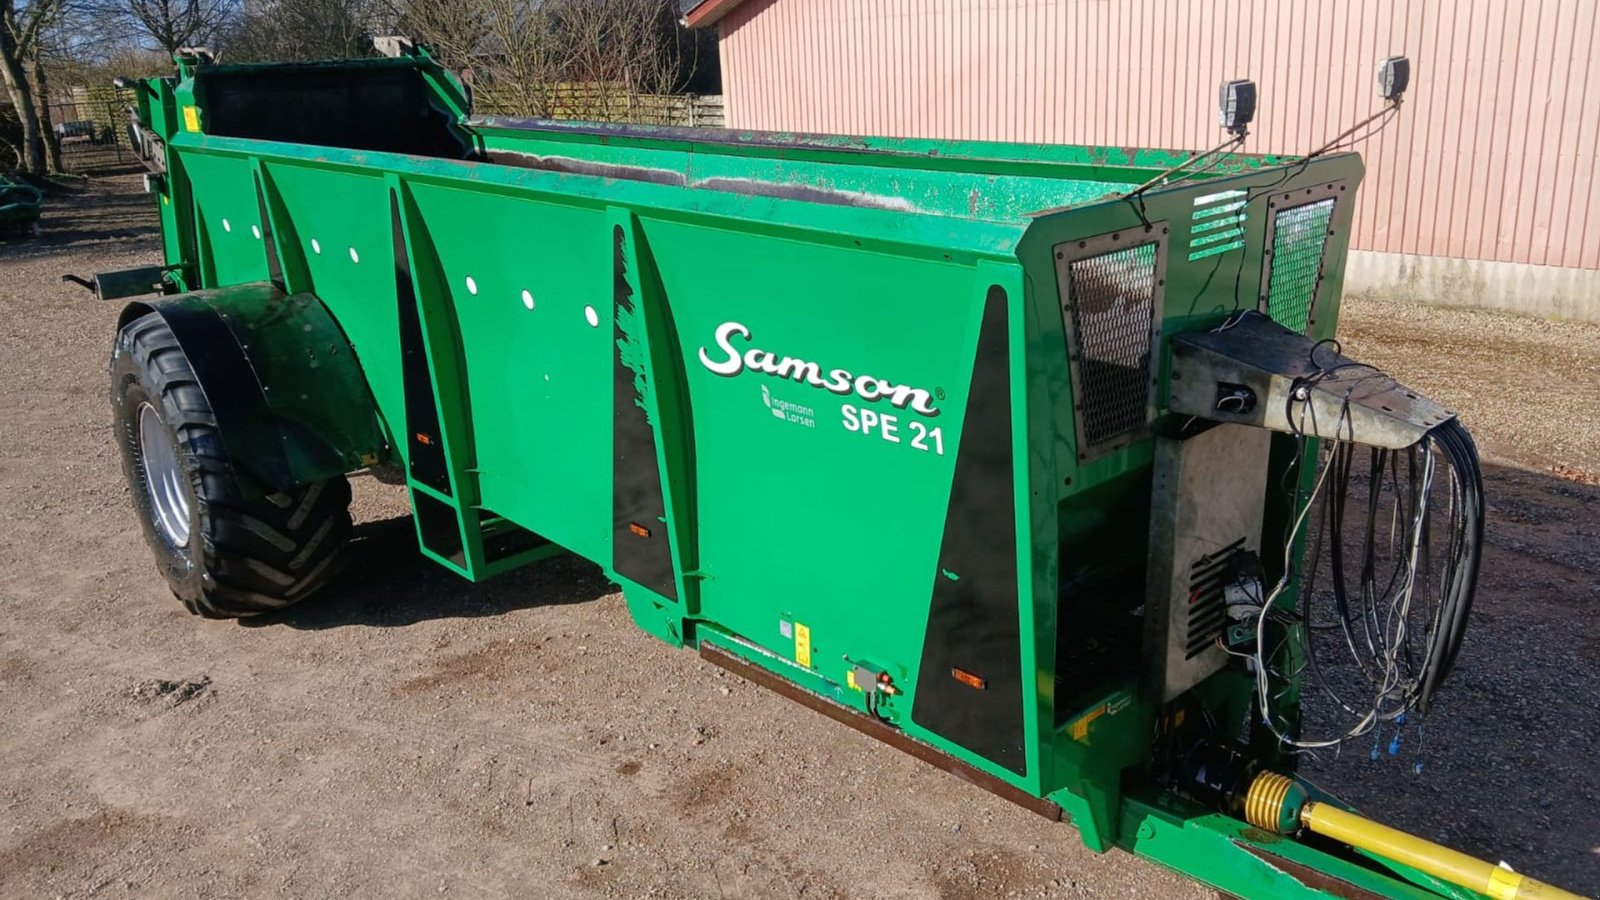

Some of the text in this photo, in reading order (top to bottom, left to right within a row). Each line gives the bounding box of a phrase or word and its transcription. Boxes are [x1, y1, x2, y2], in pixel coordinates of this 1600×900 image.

[698, 321, 941, 417] Samson
[771, 396, 815, 417] Ingemann
[786, 411, 816, 429] Larsen
[841, 404, 944, 456] SPE 21
